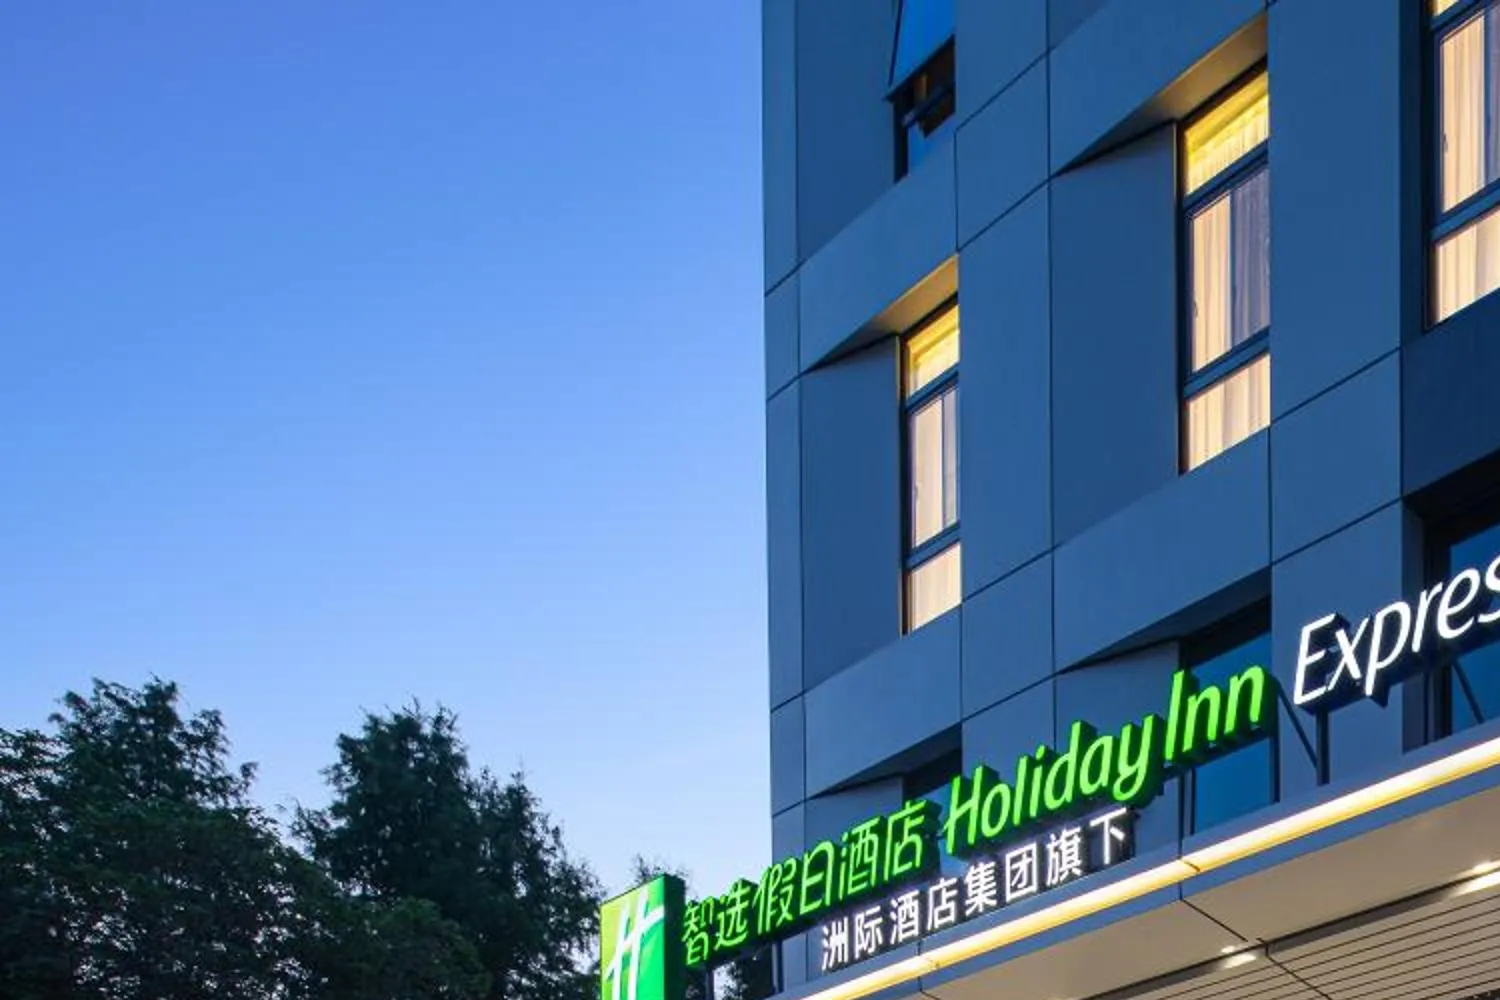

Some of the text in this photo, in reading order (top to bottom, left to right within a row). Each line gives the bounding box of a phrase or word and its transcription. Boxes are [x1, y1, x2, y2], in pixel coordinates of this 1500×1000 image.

[943, 715, 1154, 854] Holiday
[1165, 665, 1265, 762] Inn
[681, 799, 926, 967] 智选假日酒店
[821, 807, 1128, 972] 洲际酒店集团旗下
